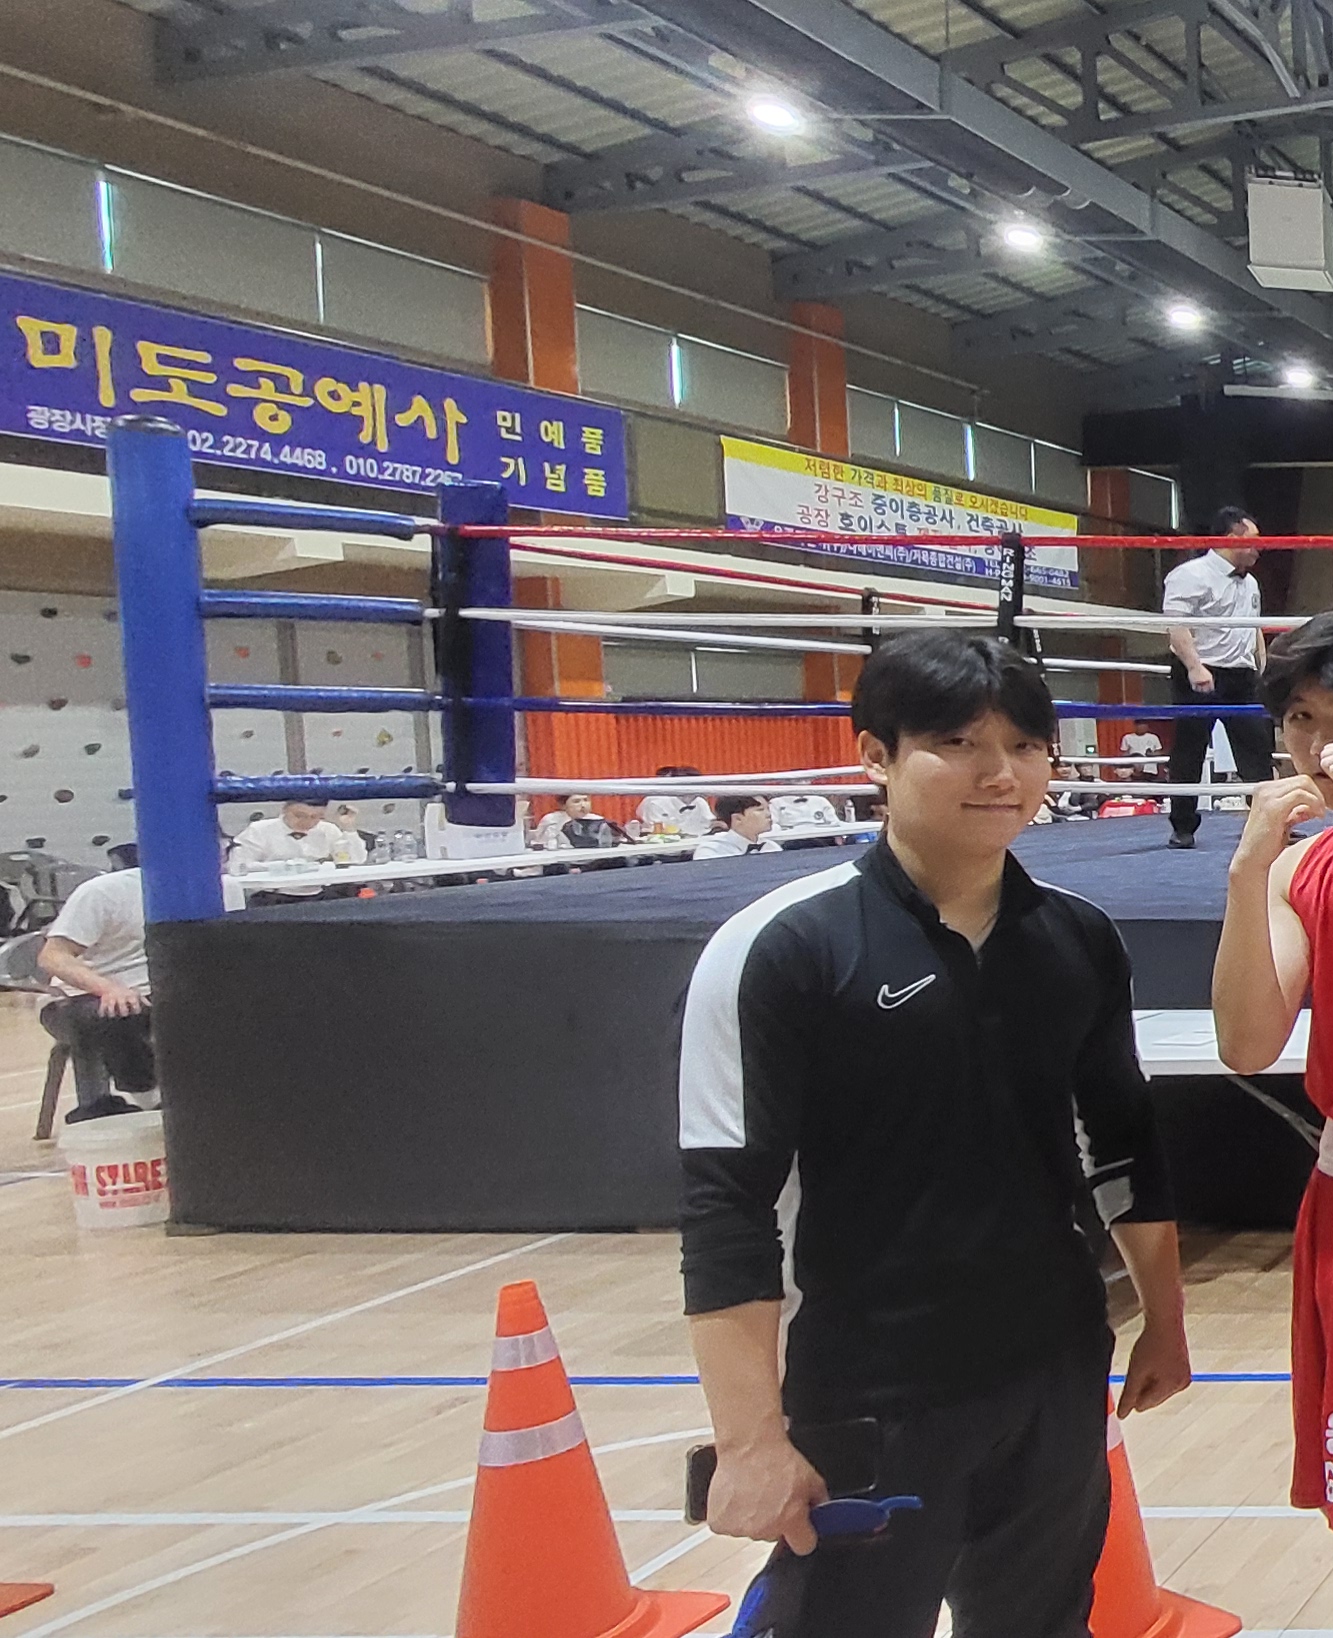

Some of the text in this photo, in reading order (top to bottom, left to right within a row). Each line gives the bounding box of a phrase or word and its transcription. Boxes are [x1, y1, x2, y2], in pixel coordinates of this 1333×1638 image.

[15, 315, 469, 465] 미도공예사
[804, 457, 845, 482] 저렴한
[851, 467, 888, 493] 가격과
[814, 482, 865, 509] 강구조
[796, 504, 831, 528] 공장
[1000, 547, 1015, 602] RINGMAN
